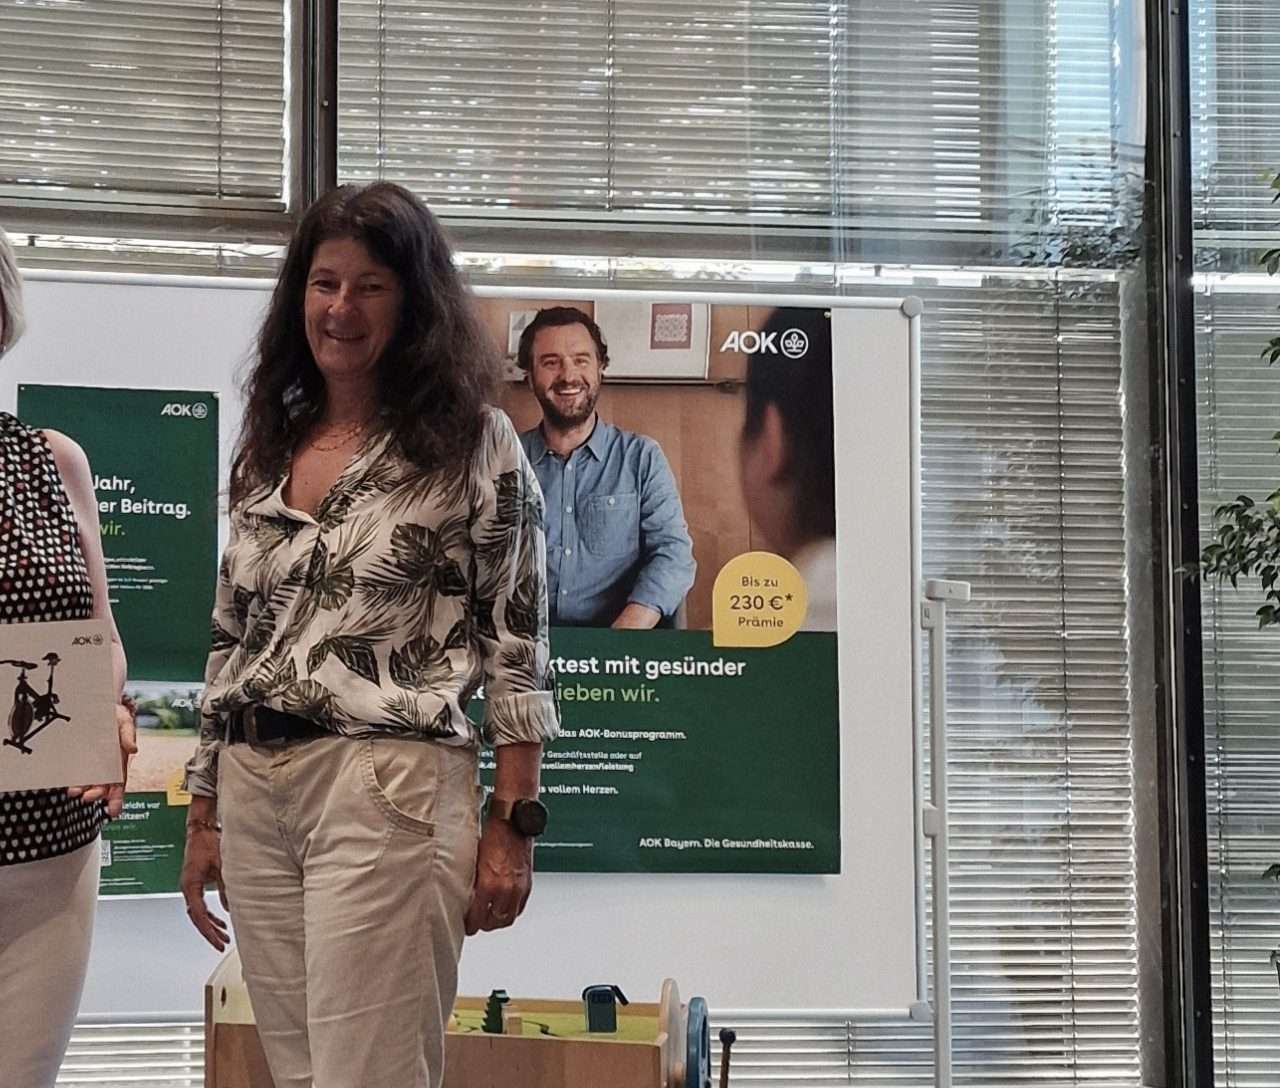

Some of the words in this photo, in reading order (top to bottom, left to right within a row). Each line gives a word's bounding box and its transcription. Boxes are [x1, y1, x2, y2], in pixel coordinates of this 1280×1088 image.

[720, 331, 779, 354] AOK
[160, 403, 192, 416] AOK
[93, 474, 136, 494] Jahr,
[120, 499, 191, 519] Beitrag.
[742, 576, 761, 587] Bis
[764, 578, 778, 588] zu
[730, 594, 764, 610] 230
[738, 615, 784, 627] Prämie
[72, 637, 92, 646] AOK
[605, 656, 641, 675] mit
[645, 656, 747, 680] gesünder
[557, 683, 615, 702] ieben
[621, 684, 660, 702] wir.
[558, 729, 577, 738] das
[578, 729, 687, 741] AOK-Bonusprogramm.
[548, 784, 580, 794] vollem
[582, 784, 619, 795] Herzen.
[639, 838, 662, 848] AOK
[664, 838, 702, 850] Bayern.
[704, 838, 720, 848] Die
[722, 839, 814, 849] Gesundheitskasse.
